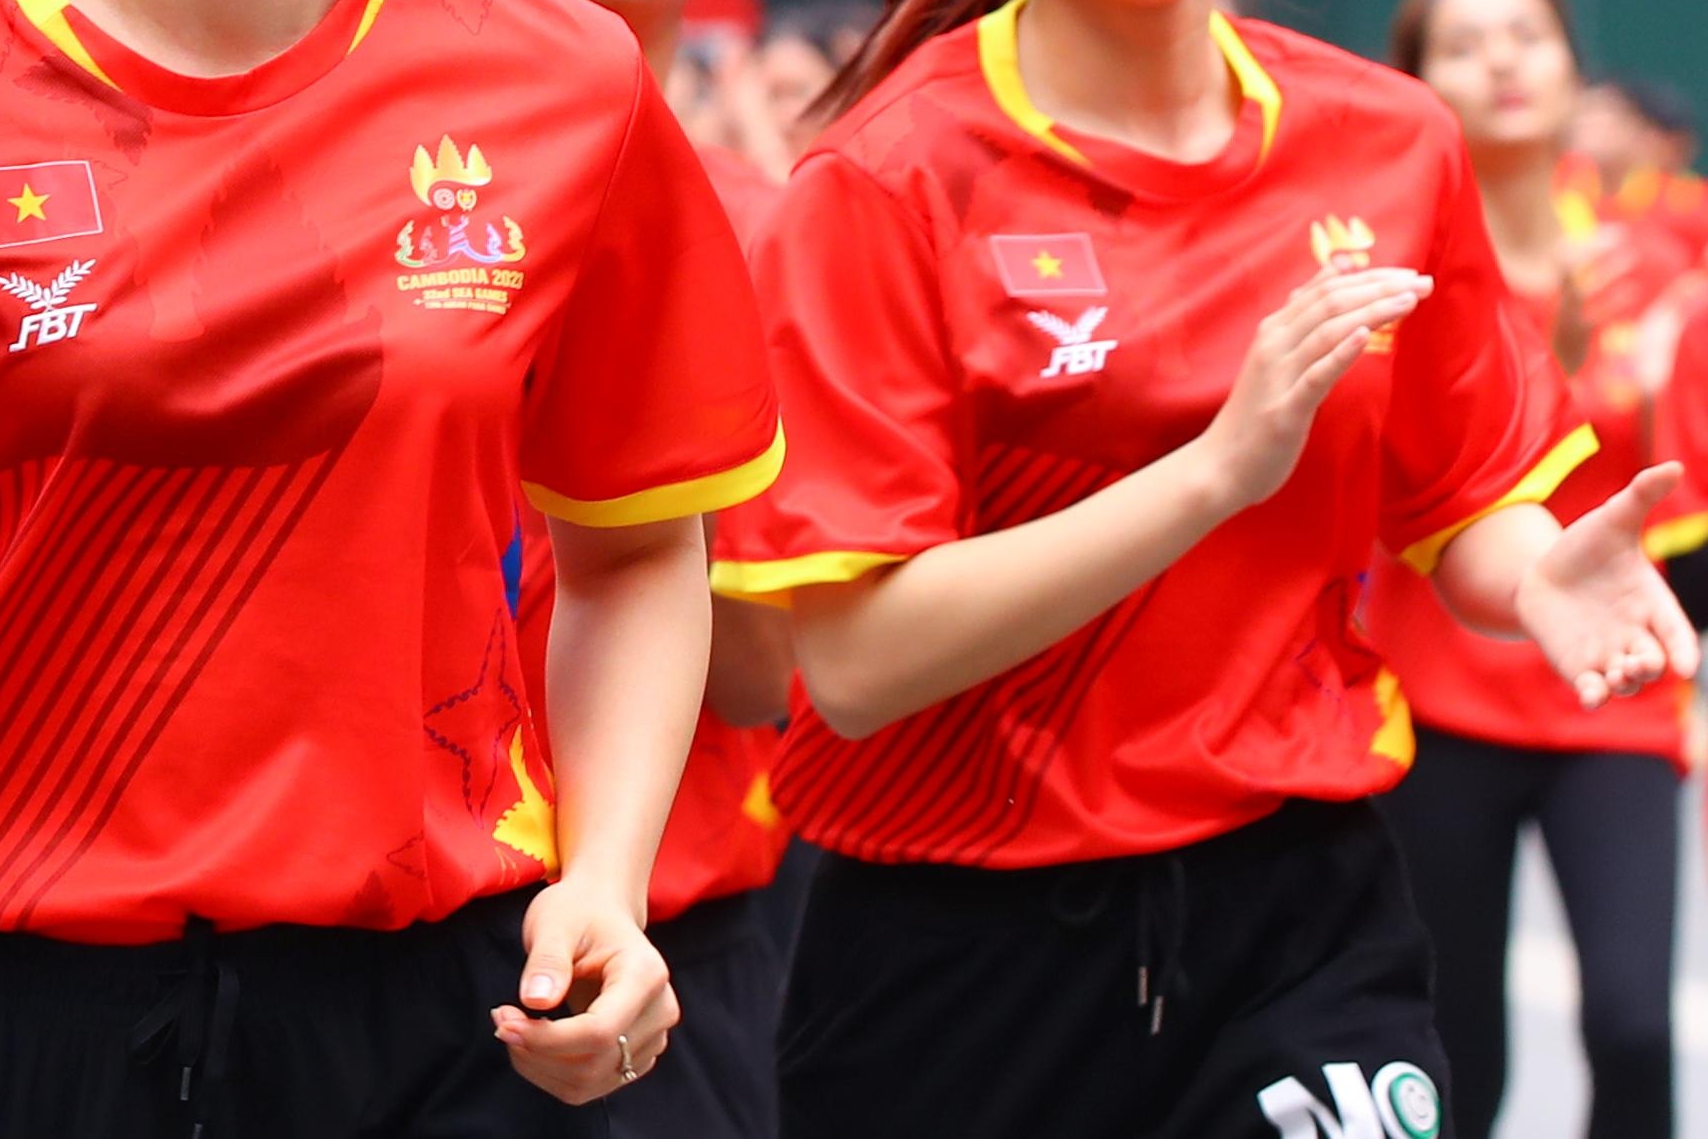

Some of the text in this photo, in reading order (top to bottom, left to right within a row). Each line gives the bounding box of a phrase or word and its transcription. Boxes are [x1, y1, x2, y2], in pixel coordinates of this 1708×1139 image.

[397, 268, 489, 291] CAMBODIA
[8, 303, 97, 353] FBT
[1040, 339, 1118, 378] FBT
